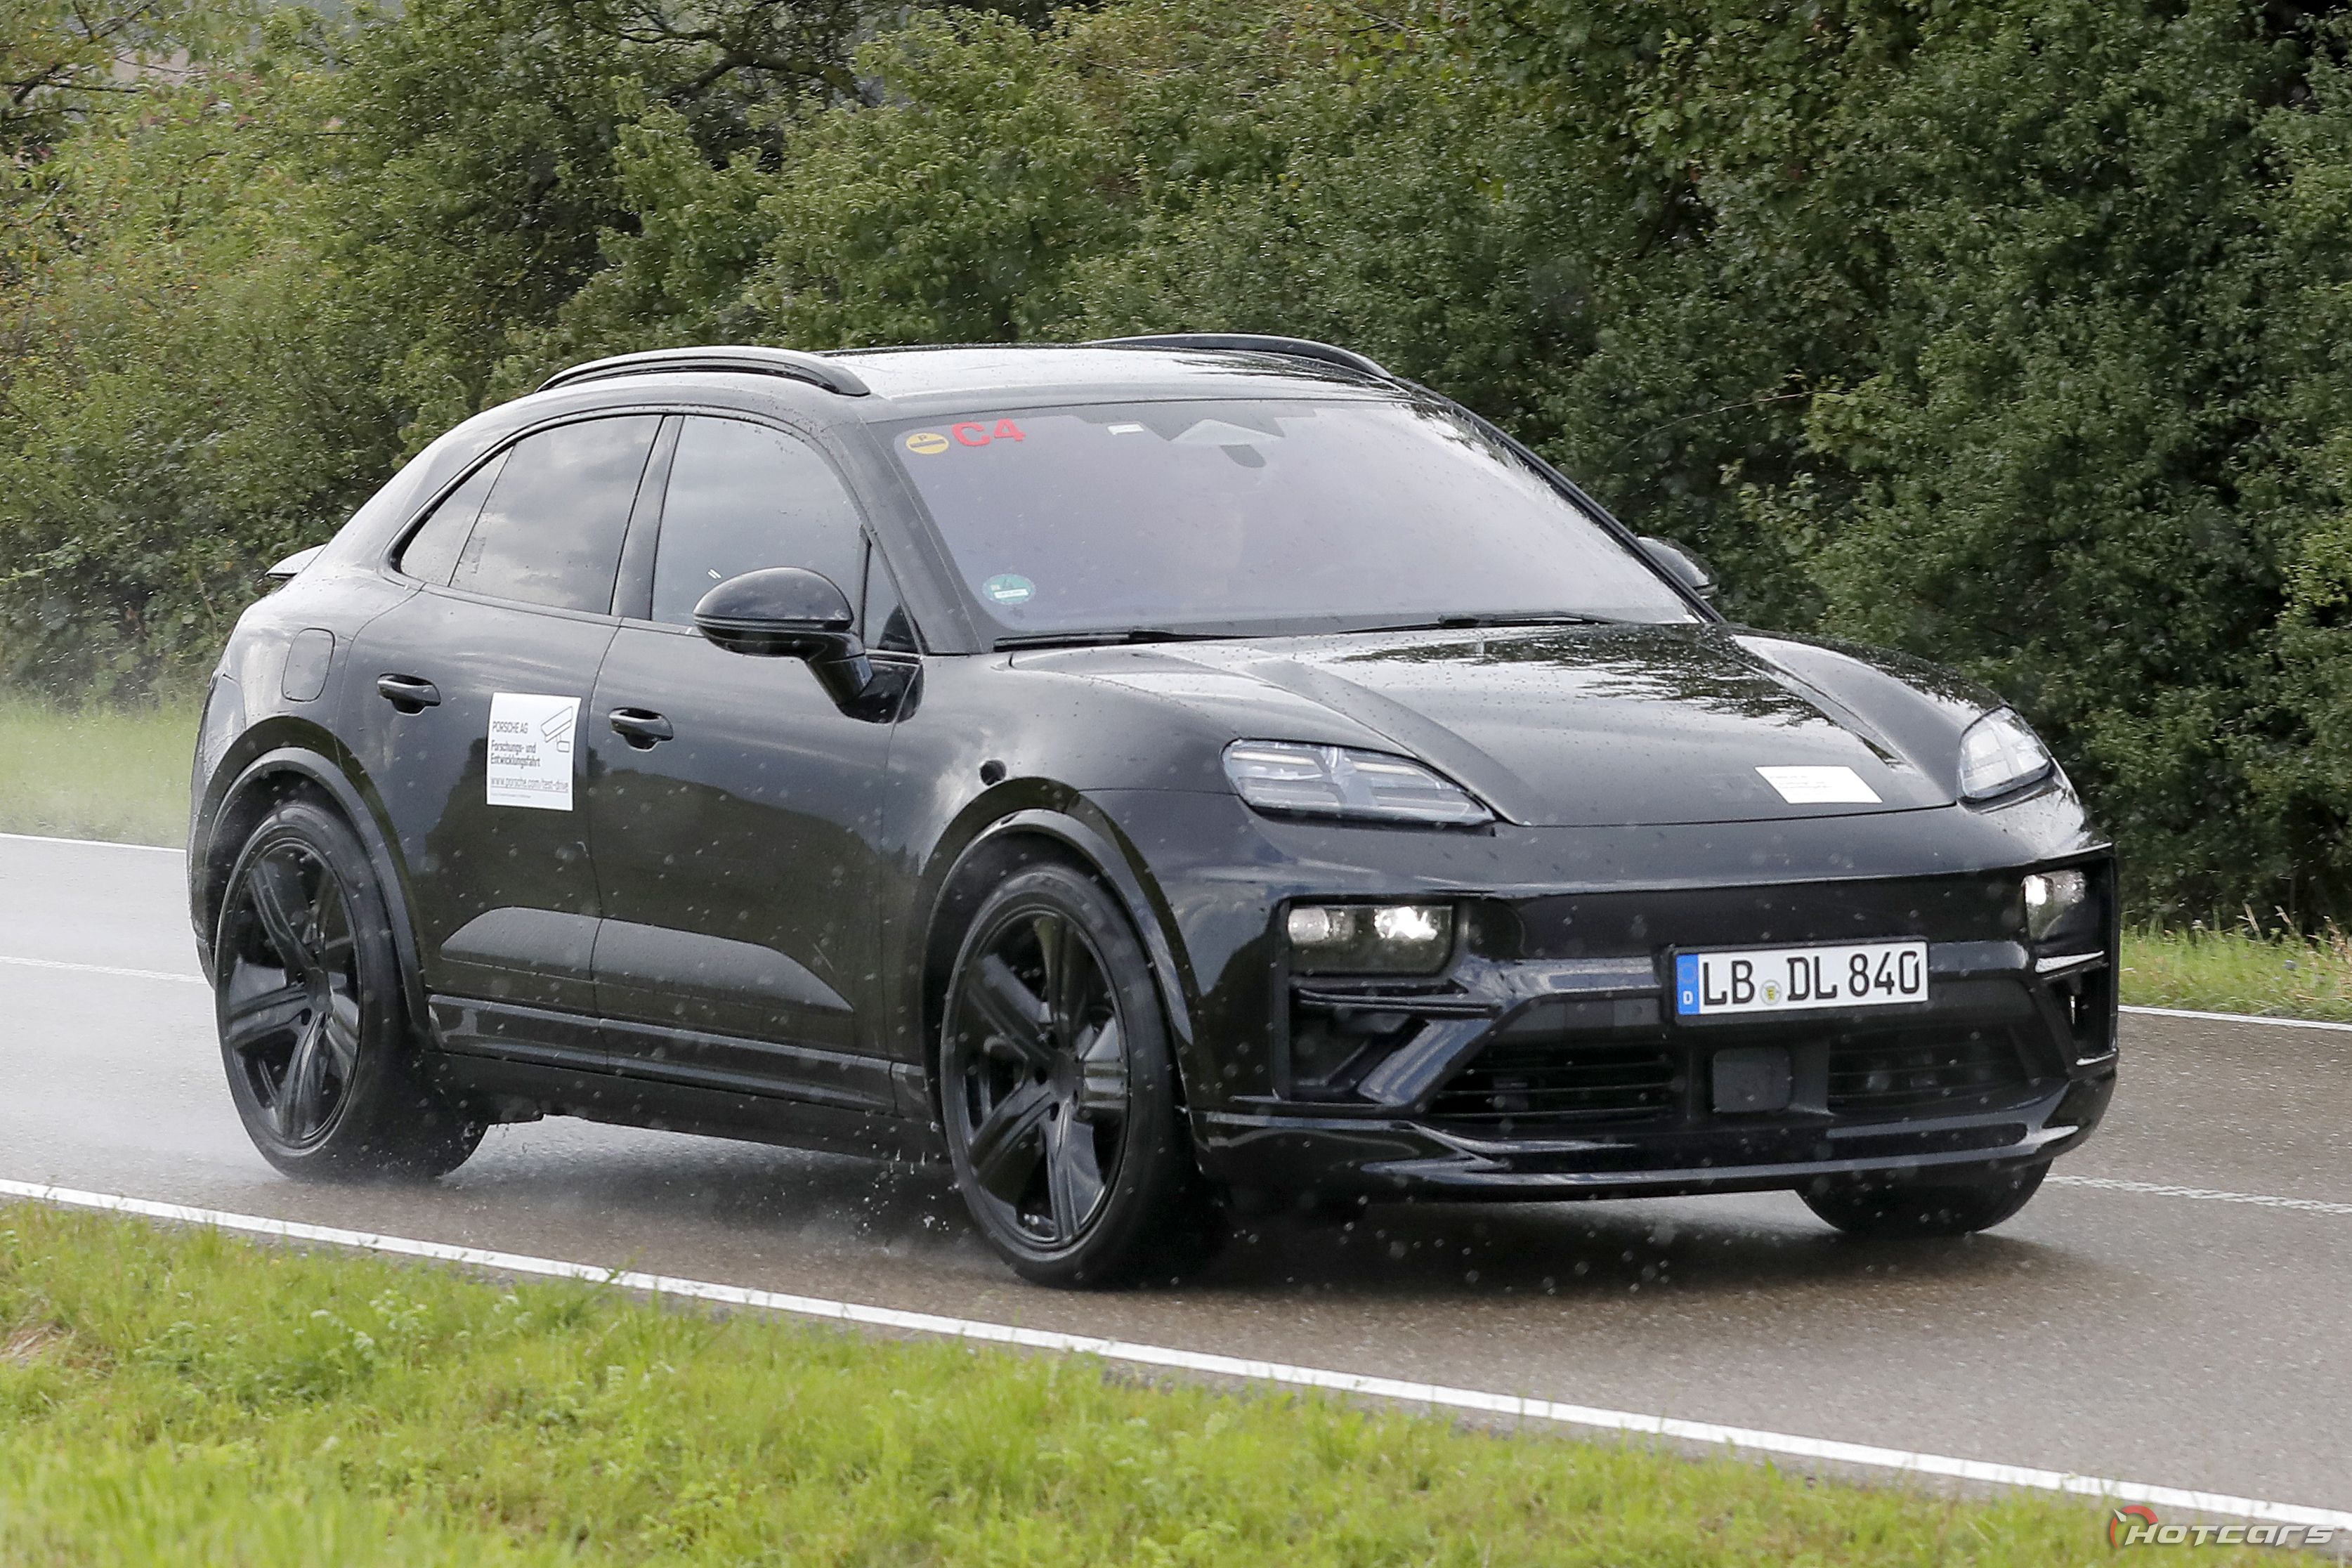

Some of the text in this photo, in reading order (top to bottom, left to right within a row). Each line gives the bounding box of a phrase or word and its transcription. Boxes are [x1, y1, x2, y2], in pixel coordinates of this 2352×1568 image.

[952, 418, 1026, 447] C4
[492, 721, 528, 734] PORSCHE AG
[492, 740, 536, 755] Forschungs- und
[490, 753, 541, 769] Entwicklungsfahrt
[1703, 950, 1921, 1006] LB DL 840
[1683, 991, 1693, 1005] D
